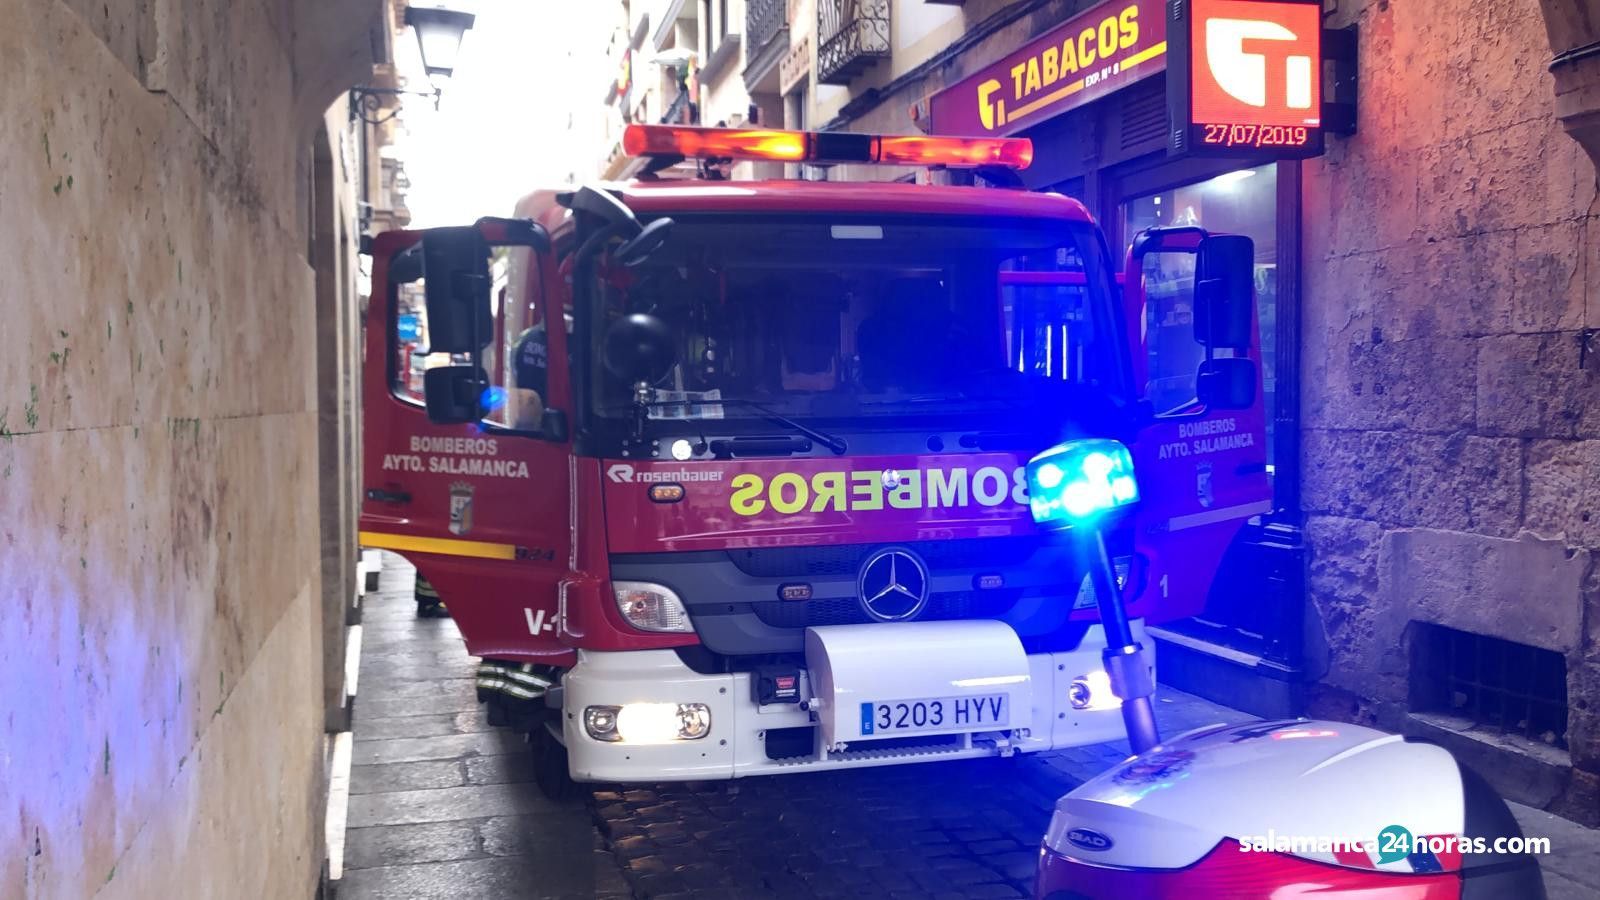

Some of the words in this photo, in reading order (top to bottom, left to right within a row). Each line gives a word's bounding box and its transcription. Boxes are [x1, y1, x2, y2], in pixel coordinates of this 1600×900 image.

[1011, 5, 1139, 100] TABACOS
[1204, 124, 1307, 147] 27/07/2019
[1178, 418, 1236, 438] BOMBEROS
[410, 436, 498, 455] BOMBEROS
[1159, 442, 1192, 460] AYTO.
[1194, 433, 1254, 455] SALAMANCA
[383, 454, 425, 472] AYTO.
[429, 457, 529, 478] SALAMANCA
[637, 467, 724, 483] rosenbauer
[878, 701, 943, 729] 3203
[955, 696, 1003, 724] HYV
